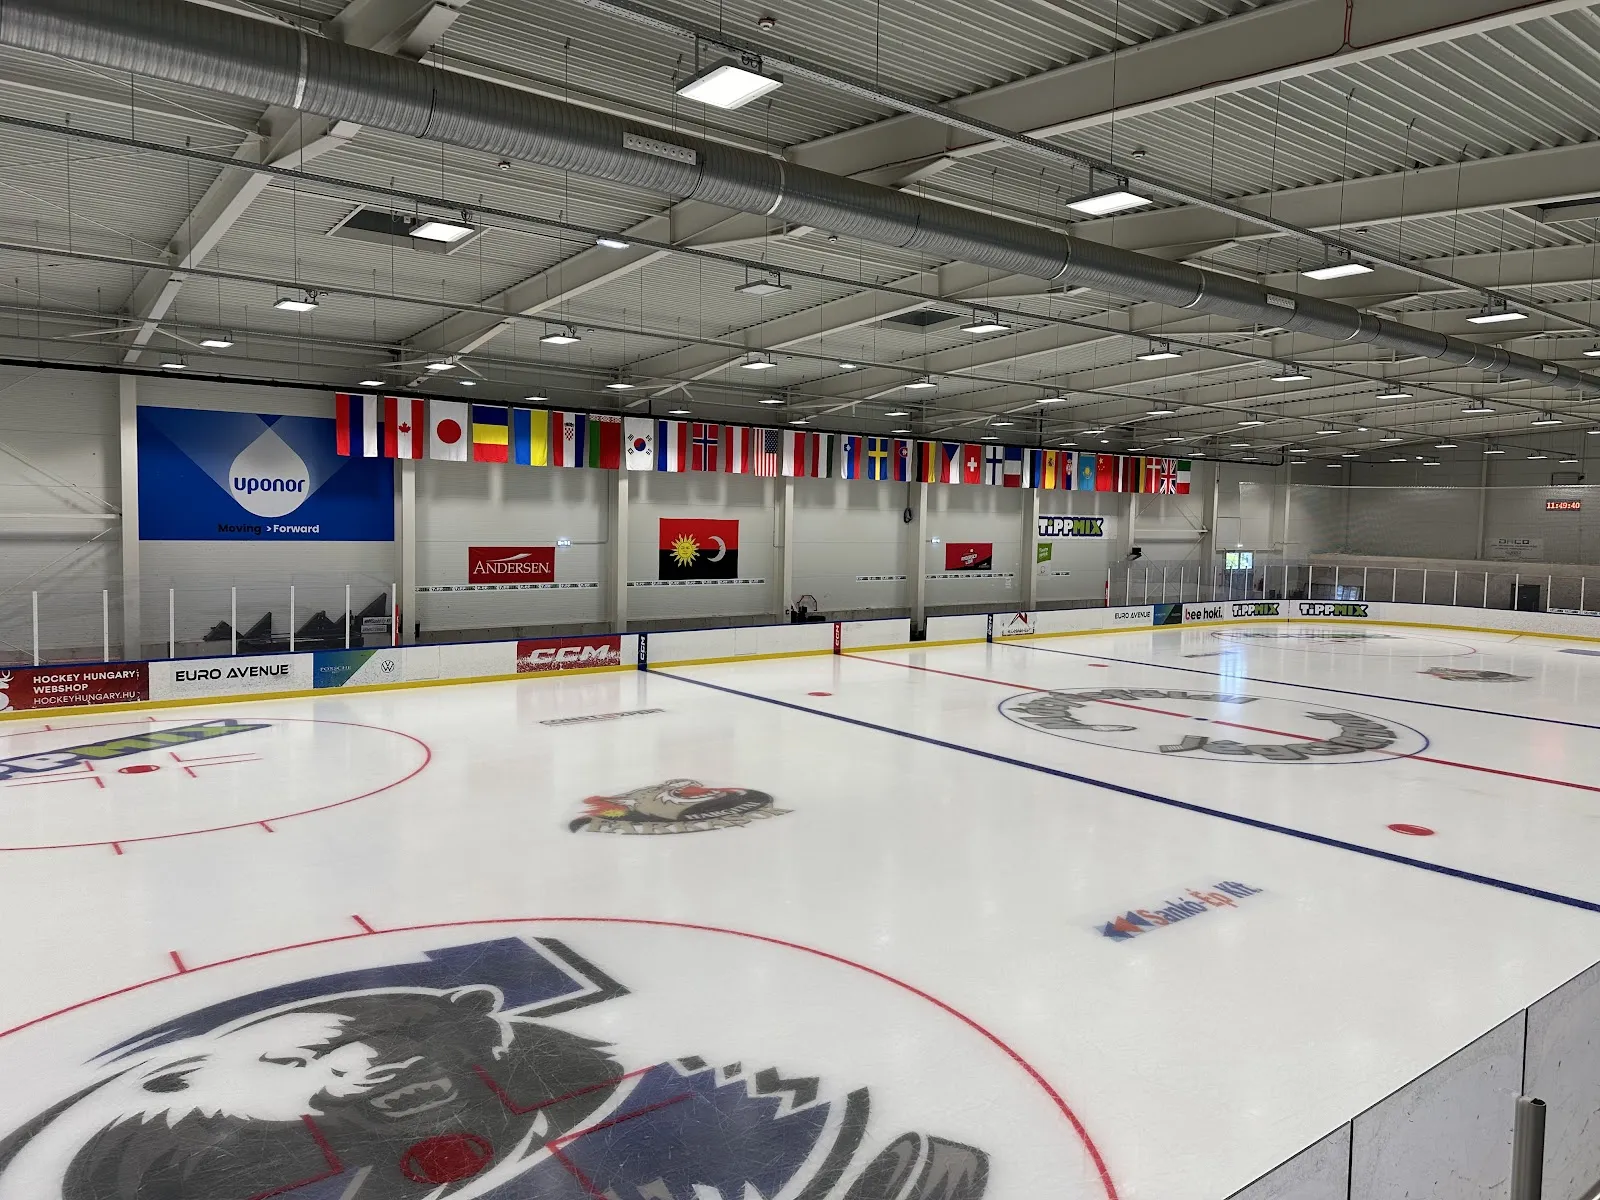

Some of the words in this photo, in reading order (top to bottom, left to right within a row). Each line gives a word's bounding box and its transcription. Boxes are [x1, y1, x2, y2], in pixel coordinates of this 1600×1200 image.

[234, 477, 306, 494] uponor
[218, 524, 261, 535] Moving
[273, 524, 320, 533] Forward
[473, 560, 549, 575] ANDERSEN
[1130, 611, 1151, 619] AVENUE
[1185, 608, 1201, 620] bee
[1203, 606, 1223, 619] hoki.
[529, 645, 610, 663] CCM
[33, 673, 80, 684] HOCKEY
[83, 670, 136, 681] HUNGARY
[175, 668, 222, 682] EURO
[226, 664, 289, 679] AVENUE
[33, 683, 89, 694] WEBSHOP
[33, 691, 136, 705] HOCKEYHUNGARY.HU
[1212, 880, 1264, 899] Kft.
